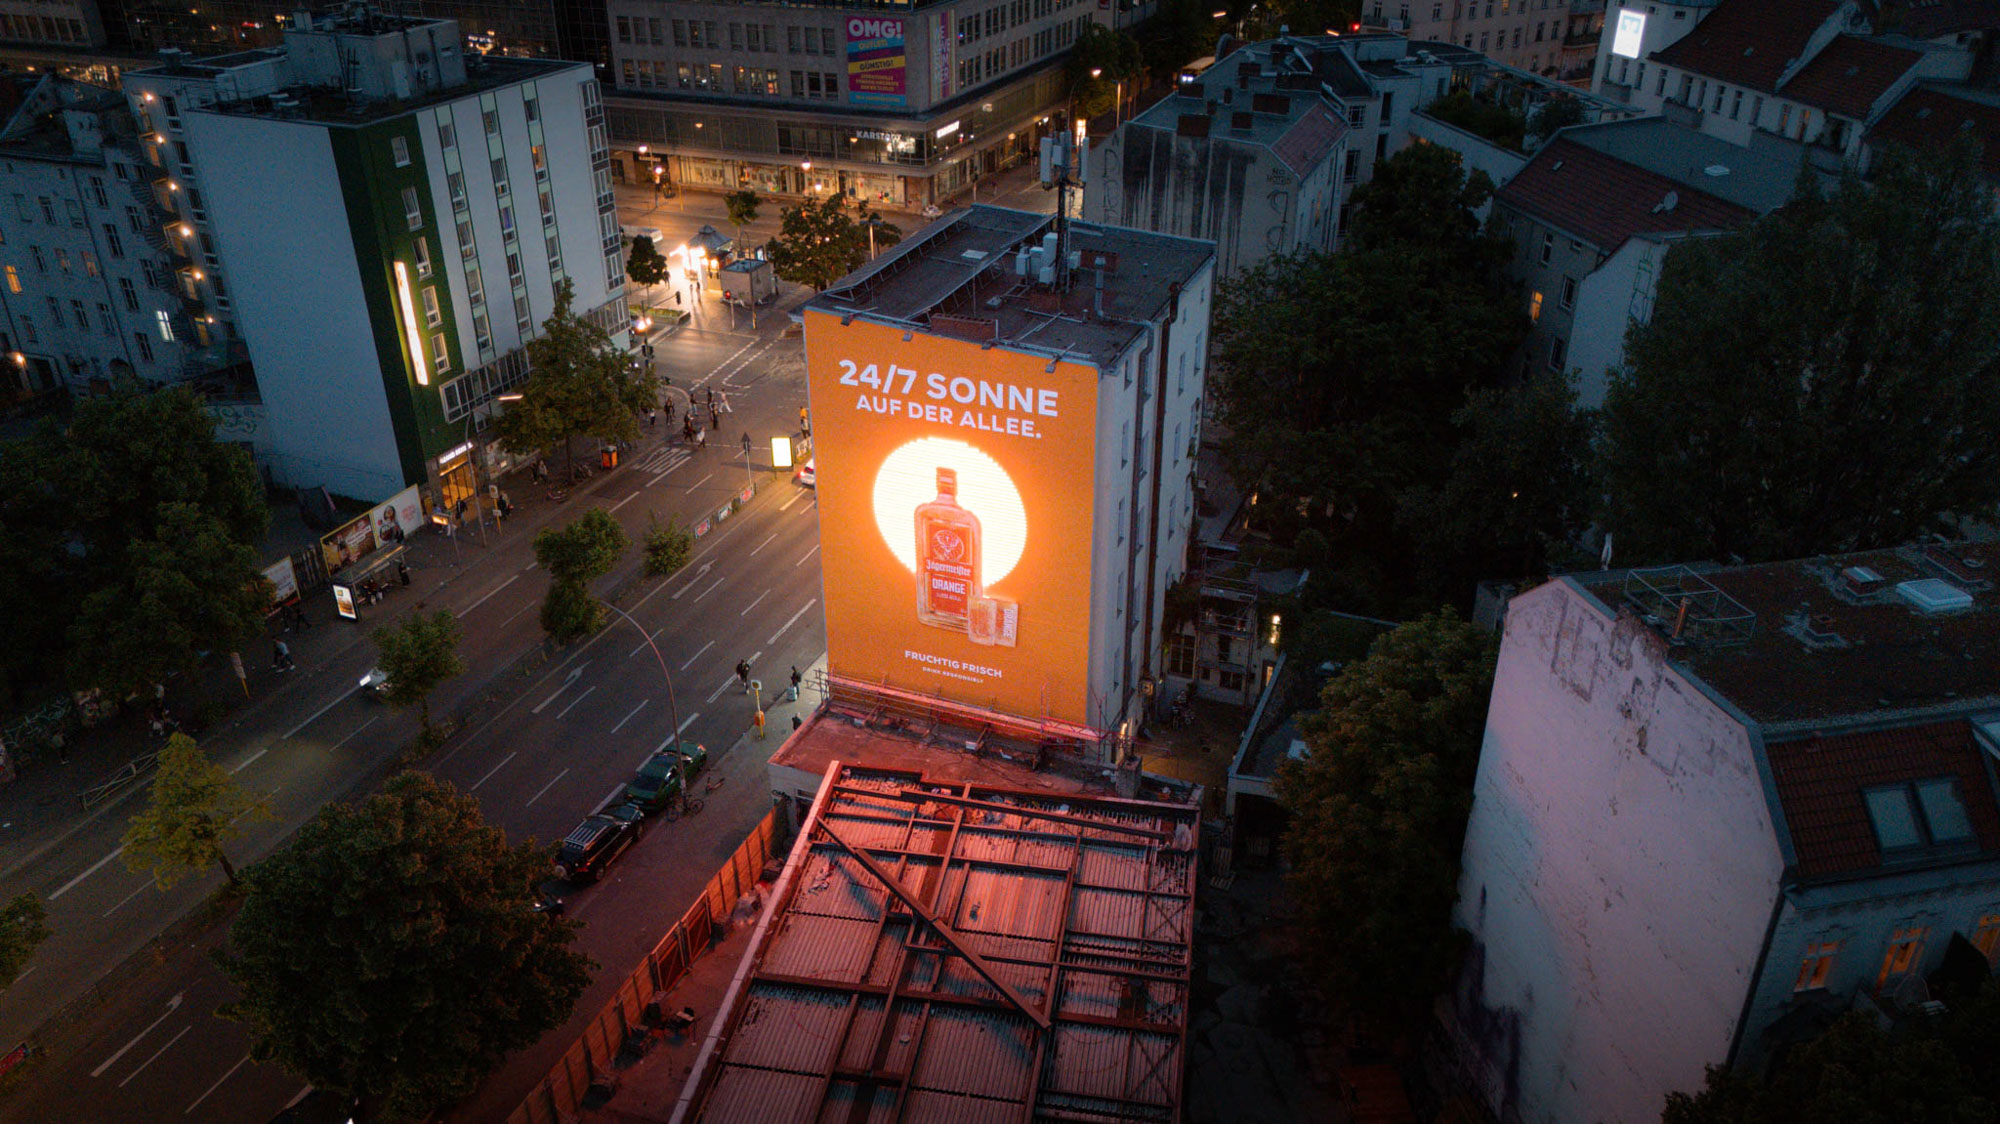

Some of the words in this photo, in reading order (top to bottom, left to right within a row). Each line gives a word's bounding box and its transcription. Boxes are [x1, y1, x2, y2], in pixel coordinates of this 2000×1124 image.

[848, 19, 902, 40] OMG!
[856, 130, 902, 142] KARSTADT
[839, 359, 917, 394] 24/7
[926, 373, 1059, 417] SONNE
[856, 394, 902, 416] AUF
[908, 402, 953, 425] DER
[959, 410, 1042, 439] ALLEE.
[932, 578, 966, 595] ORANGE
[904, 650, 960, 669] FRUCHTIG
[962, 662, 1002, 678] FRISCH
[922, 666, 941, 675] DRINK
